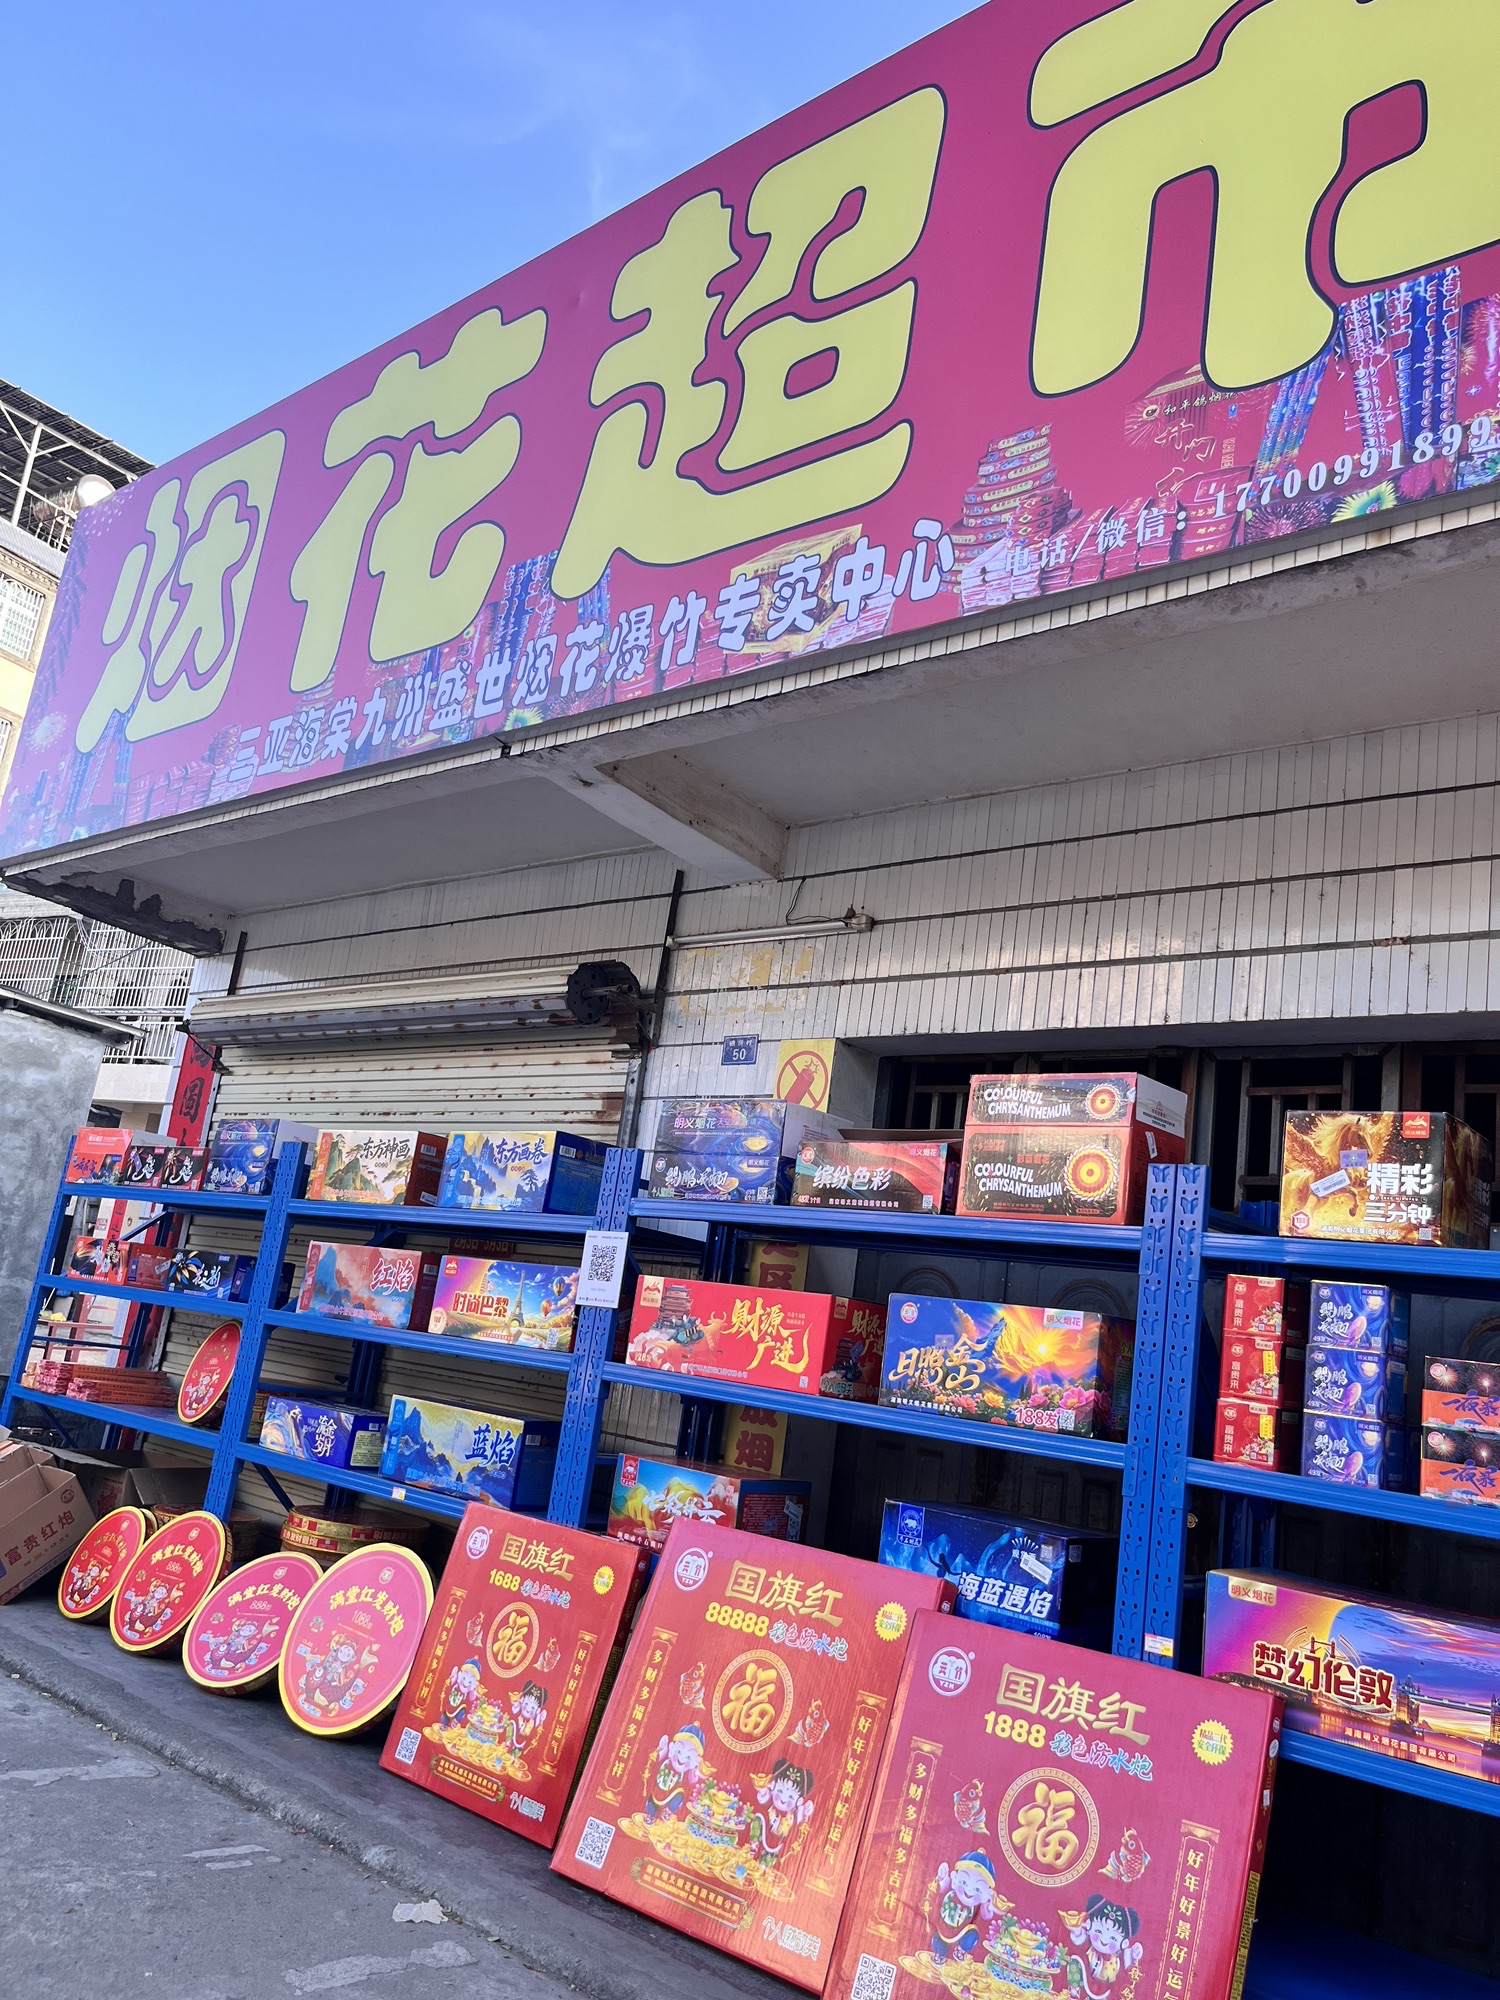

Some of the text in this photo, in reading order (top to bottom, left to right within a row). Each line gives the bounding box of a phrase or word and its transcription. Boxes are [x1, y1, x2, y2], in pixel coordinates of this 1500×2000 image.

[228, 518, 955, 784] 三亚海棠九州盛世烟花爆竹专卖中心
[732, 1048, 746, 1061] 50
[983, 1086, 1044, 1105] COLOURFUL
[988, 1102, 1071, 1120] CHRYSANTHEMUM
[360, 1136, 411, 1162] 东方神画
[493, 1136, 549, 1167] 东方画卷
[812, 1165, 893, 1191] 缤纷色彩
[974, 1162, 1034, 1183] COLOURFUL
[979, 1178, 1063, 1198] CHRYSANTHEMUM
[1366, 1163, 1434, 1195] 精彩
[1363, 1201, 1432, 1225] 三分钟
[369, 1257, 415, 1296] 红焰
[452, 1290, 510, 1319] 时尚巴黎
[721, 1297, 803, 1342] 财源
[1045, 1313, 1082, 1327] 明义烟花
[746, 1323, 814, 1374] 广进
[1015, 1407, 1059, 1430] 188发
[464, 1422, 515, 1467] 蓝焰
[5, 1510, 75, 1566] 富贵红炮
[499, 1532, 575, 1582] 国旗红
[489, 1568, 522, 1592] 1688
[724, 1559, 845, 1628] 国旗红
[957, 1571, 1054, 1619] 海蓝遇焰
[1230, 1584, 1274, 1603] 明义烟花
[329, 1585, 405, 1638] 满堂红发财炮
[705, 1601, 848, 1662] 88888 彩色防水炮
[493, 1611, 530, 1666] 福
[1253, 1640, 1395, 1711] 梦幻伦敦
[550, 1649, 588, 1754] 好年好景好运气
[610, 1648, 663, 1783] 多财多福多吉祥
[722, 1661, 775, 1737] 福
[995, 1662, 1151, 1746] 国旗红
[983, 1710, 1154, 1782] 1888 彩色防水炮
[1344, 1726, 1457, 1763] 湖南明义烟花集团有限公司
[824, 1713, 871, 1866] 好年好景好运气
[881, 1761, 928, 1910] 多财多福多吉祥
[1012, 1781, 1081, 1870] 福
